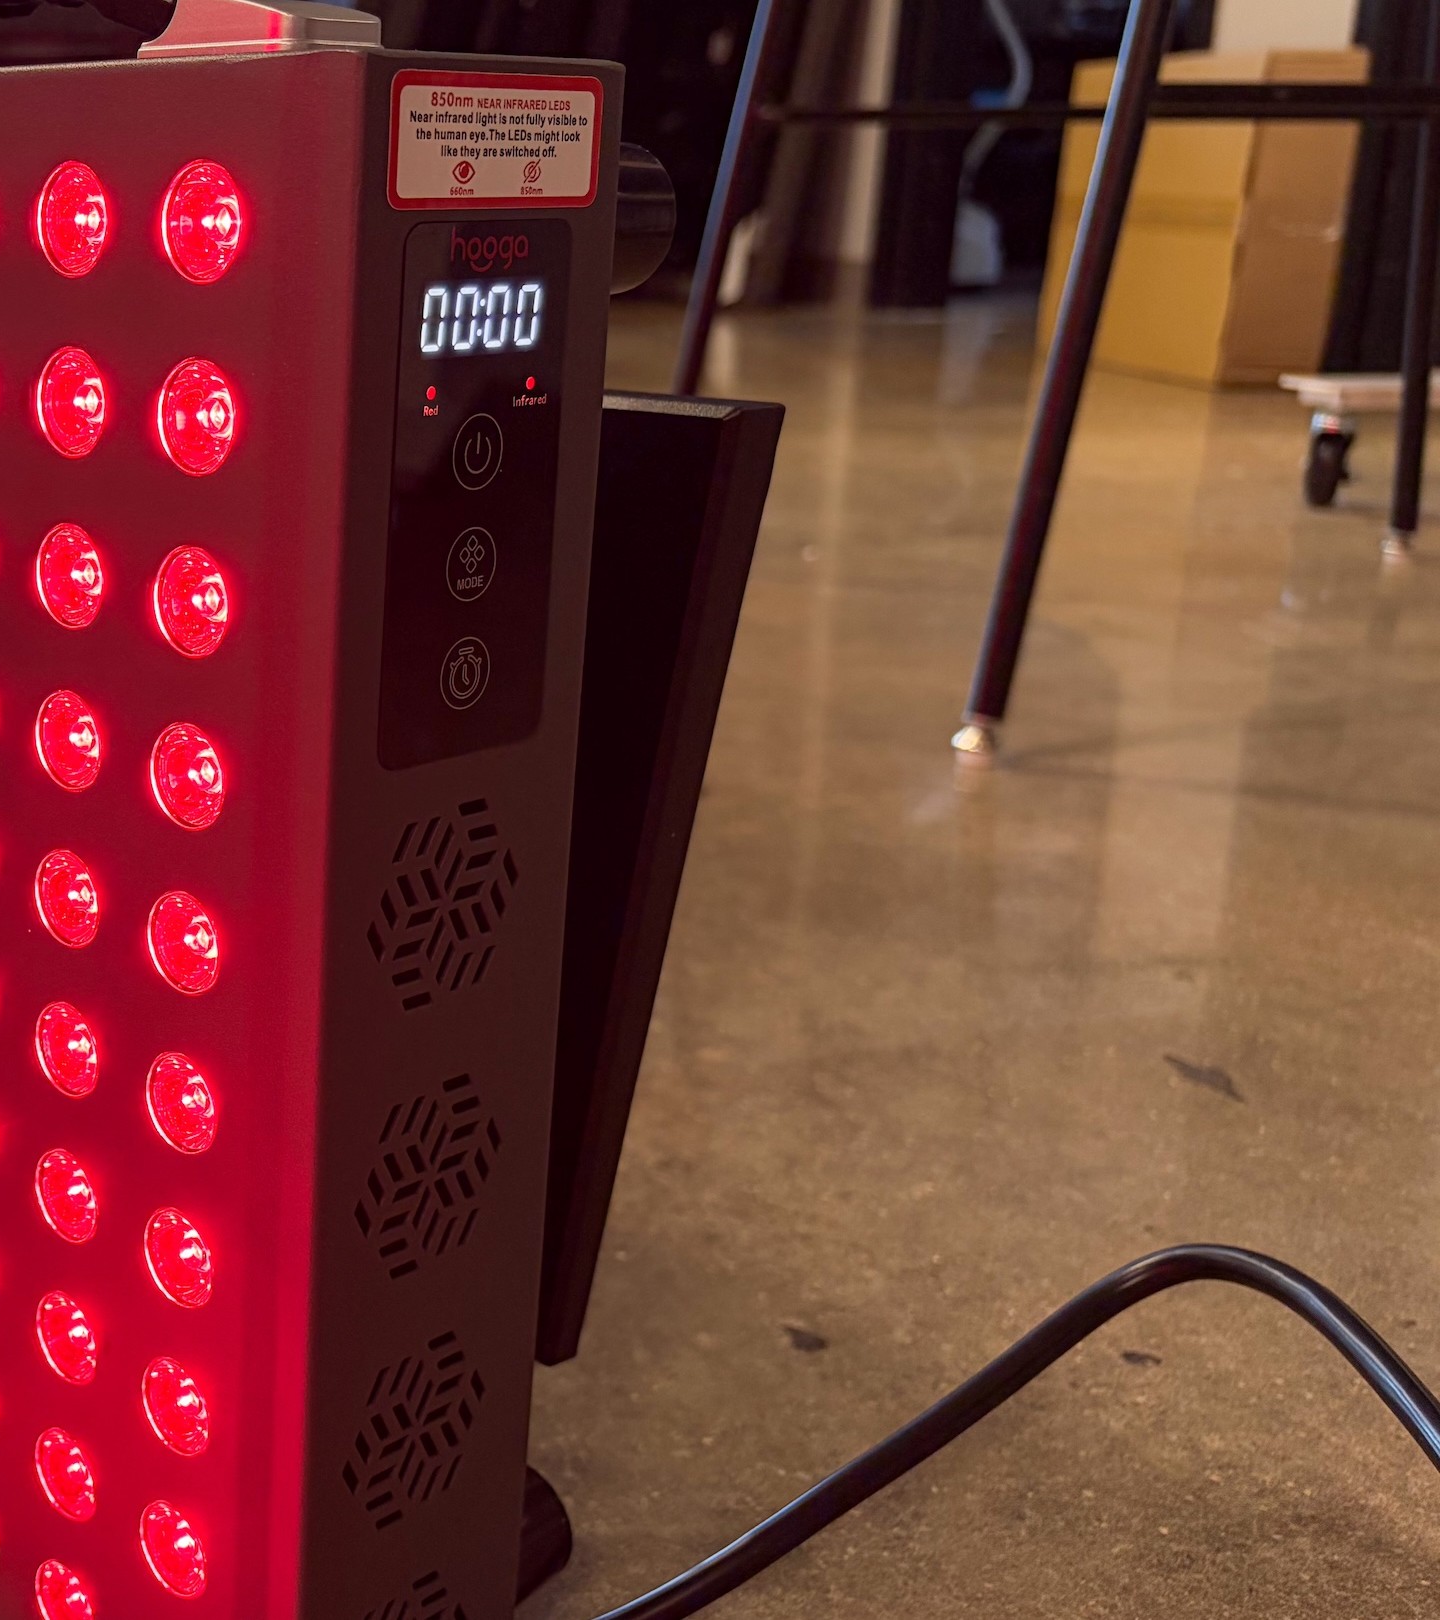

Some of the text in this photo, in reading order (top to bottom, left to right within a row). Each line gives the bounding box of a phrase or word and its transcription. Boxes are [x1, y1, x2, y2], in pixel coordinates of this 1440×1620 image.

[431, 92, 570, 110] 850nm NEAR INFRARED LEDS
[410, 111, 587, 127] Near infrared light is not fully visible to
[416, 128, 432, 139] the
[434, 129, 467, 140] human
[508, 130, 532, 141] LEDs
[534, 130, 559, 144] might
[561, 131, 580, 142] look
[441, 146, 557, 160] like they are switched off.
[450, 187, 474, 195] 660nm
[521, 187, 543, 195] 850nm
[450, 226, 529, 272] hooga
[421, 284, 541, 352] 00:00
[513, 394, 547, 407] Infrared
[423, 405, 438, 416] Red
[457, 575, 484, 590] MODE
